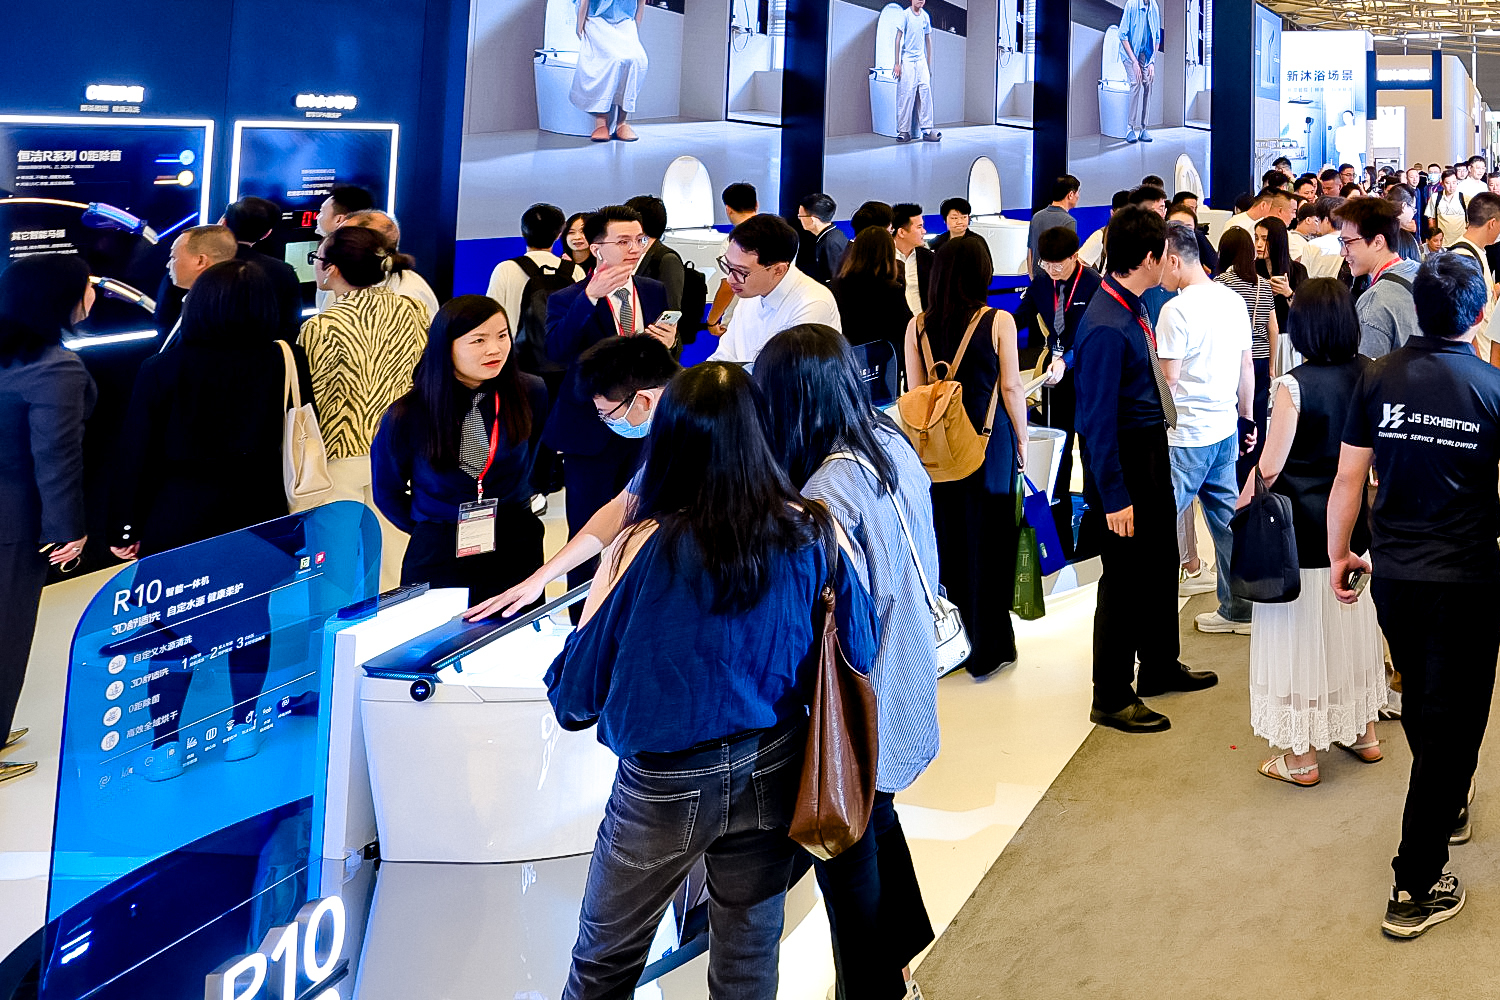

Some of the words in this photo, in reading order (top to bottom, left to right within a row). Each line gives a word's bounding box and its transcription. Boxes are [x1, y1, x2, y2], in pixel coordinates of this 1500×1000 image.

[1286, 69, 1354, 82] 新沐浴场景
[1407, 412, 1422, 424] JS
[1423, 414, 1481, 434] EXHIBITION
[1409, 433, 1435, 444] SERVICE
[1436, 438, 1479, 450] WORLDWIDE
[166, 594, 207, 618] 自定水源
